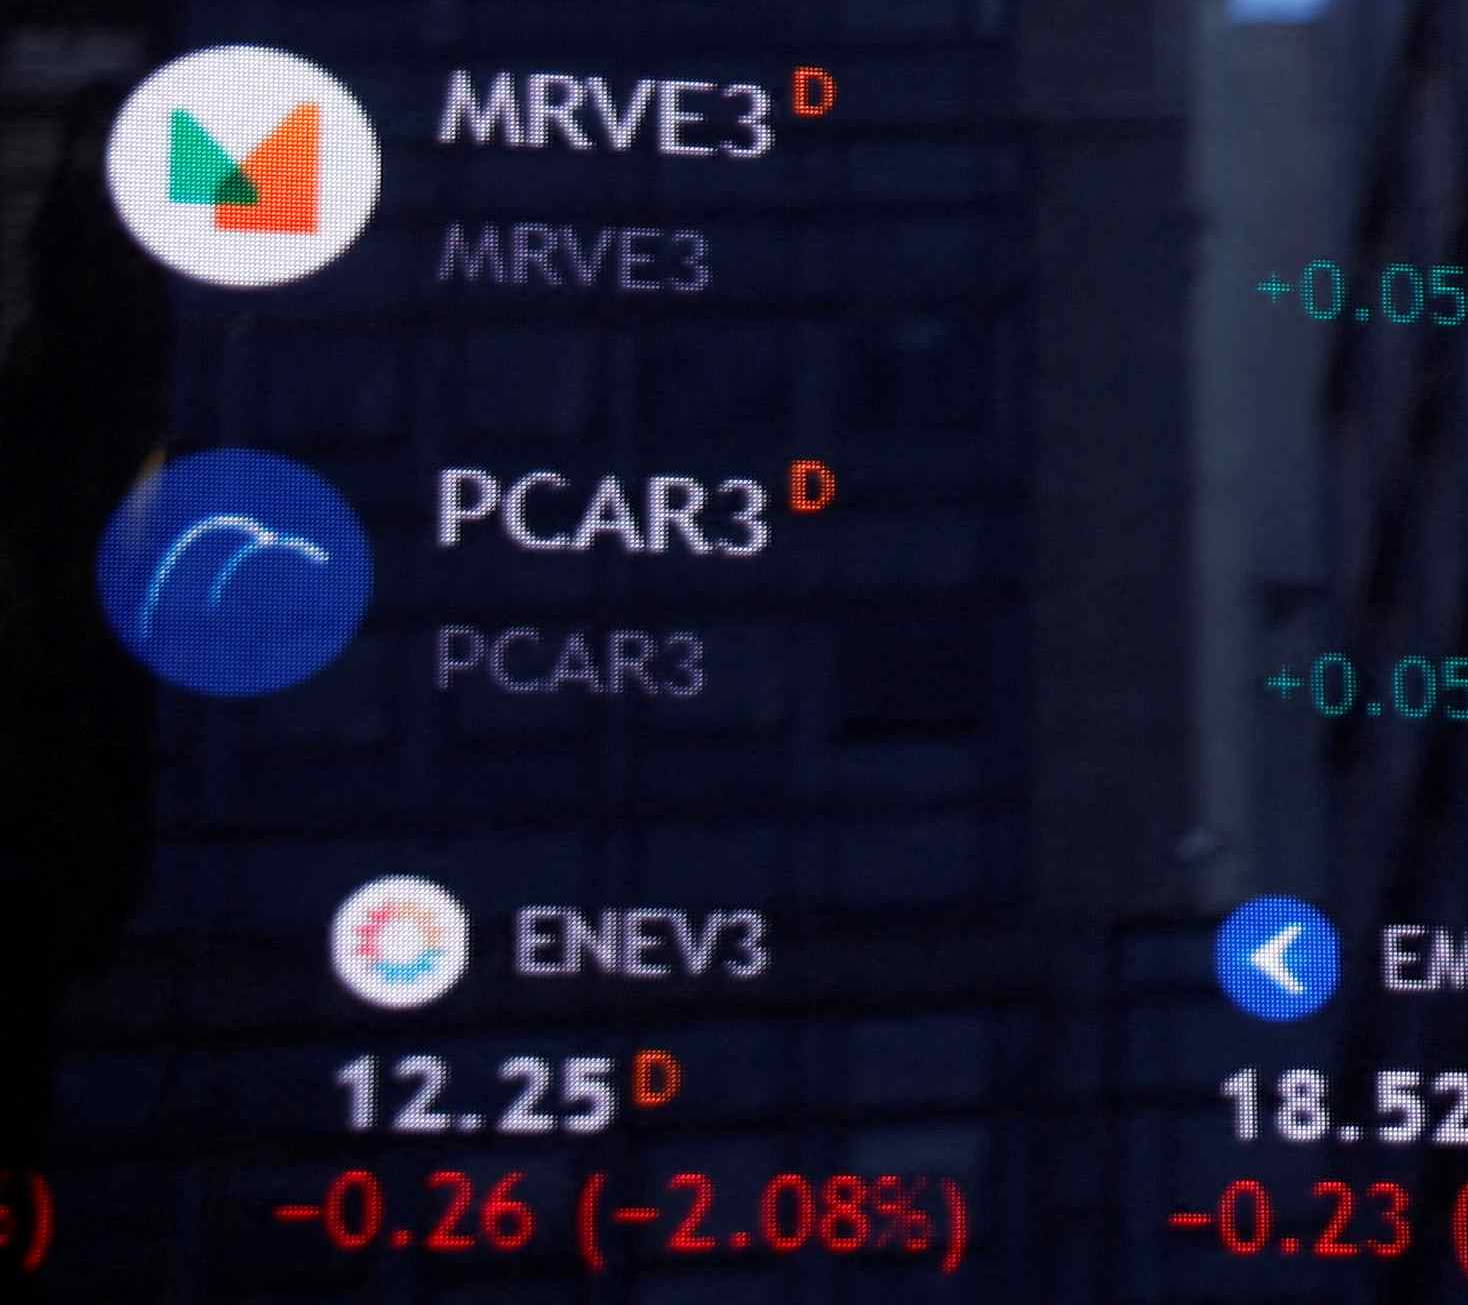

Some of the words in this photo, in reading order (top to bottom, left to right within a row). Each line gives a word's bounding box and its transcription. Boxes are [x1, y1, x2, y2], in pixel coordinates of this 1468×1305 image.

[437, 67, 775, 160] MRVE3
[790, 66, 838, 118] D
[436, 221, 711, 294] MRVE3
[437, 466, 772, 558] PCAR3
[789, 460, 836, 512] D
[434, 624, 707, 698] PCAR3
[515, 904, 771, 979] ENEV3
[334, 1053, 621, 1135] 12.25
[632, 1049, 682, 1107] D
[273, 1169, 536, 1252] -0.26
[578, 1171, 968, 1276] (-2.08%)
[1169, 1179, 1412, 1258] -0.23
